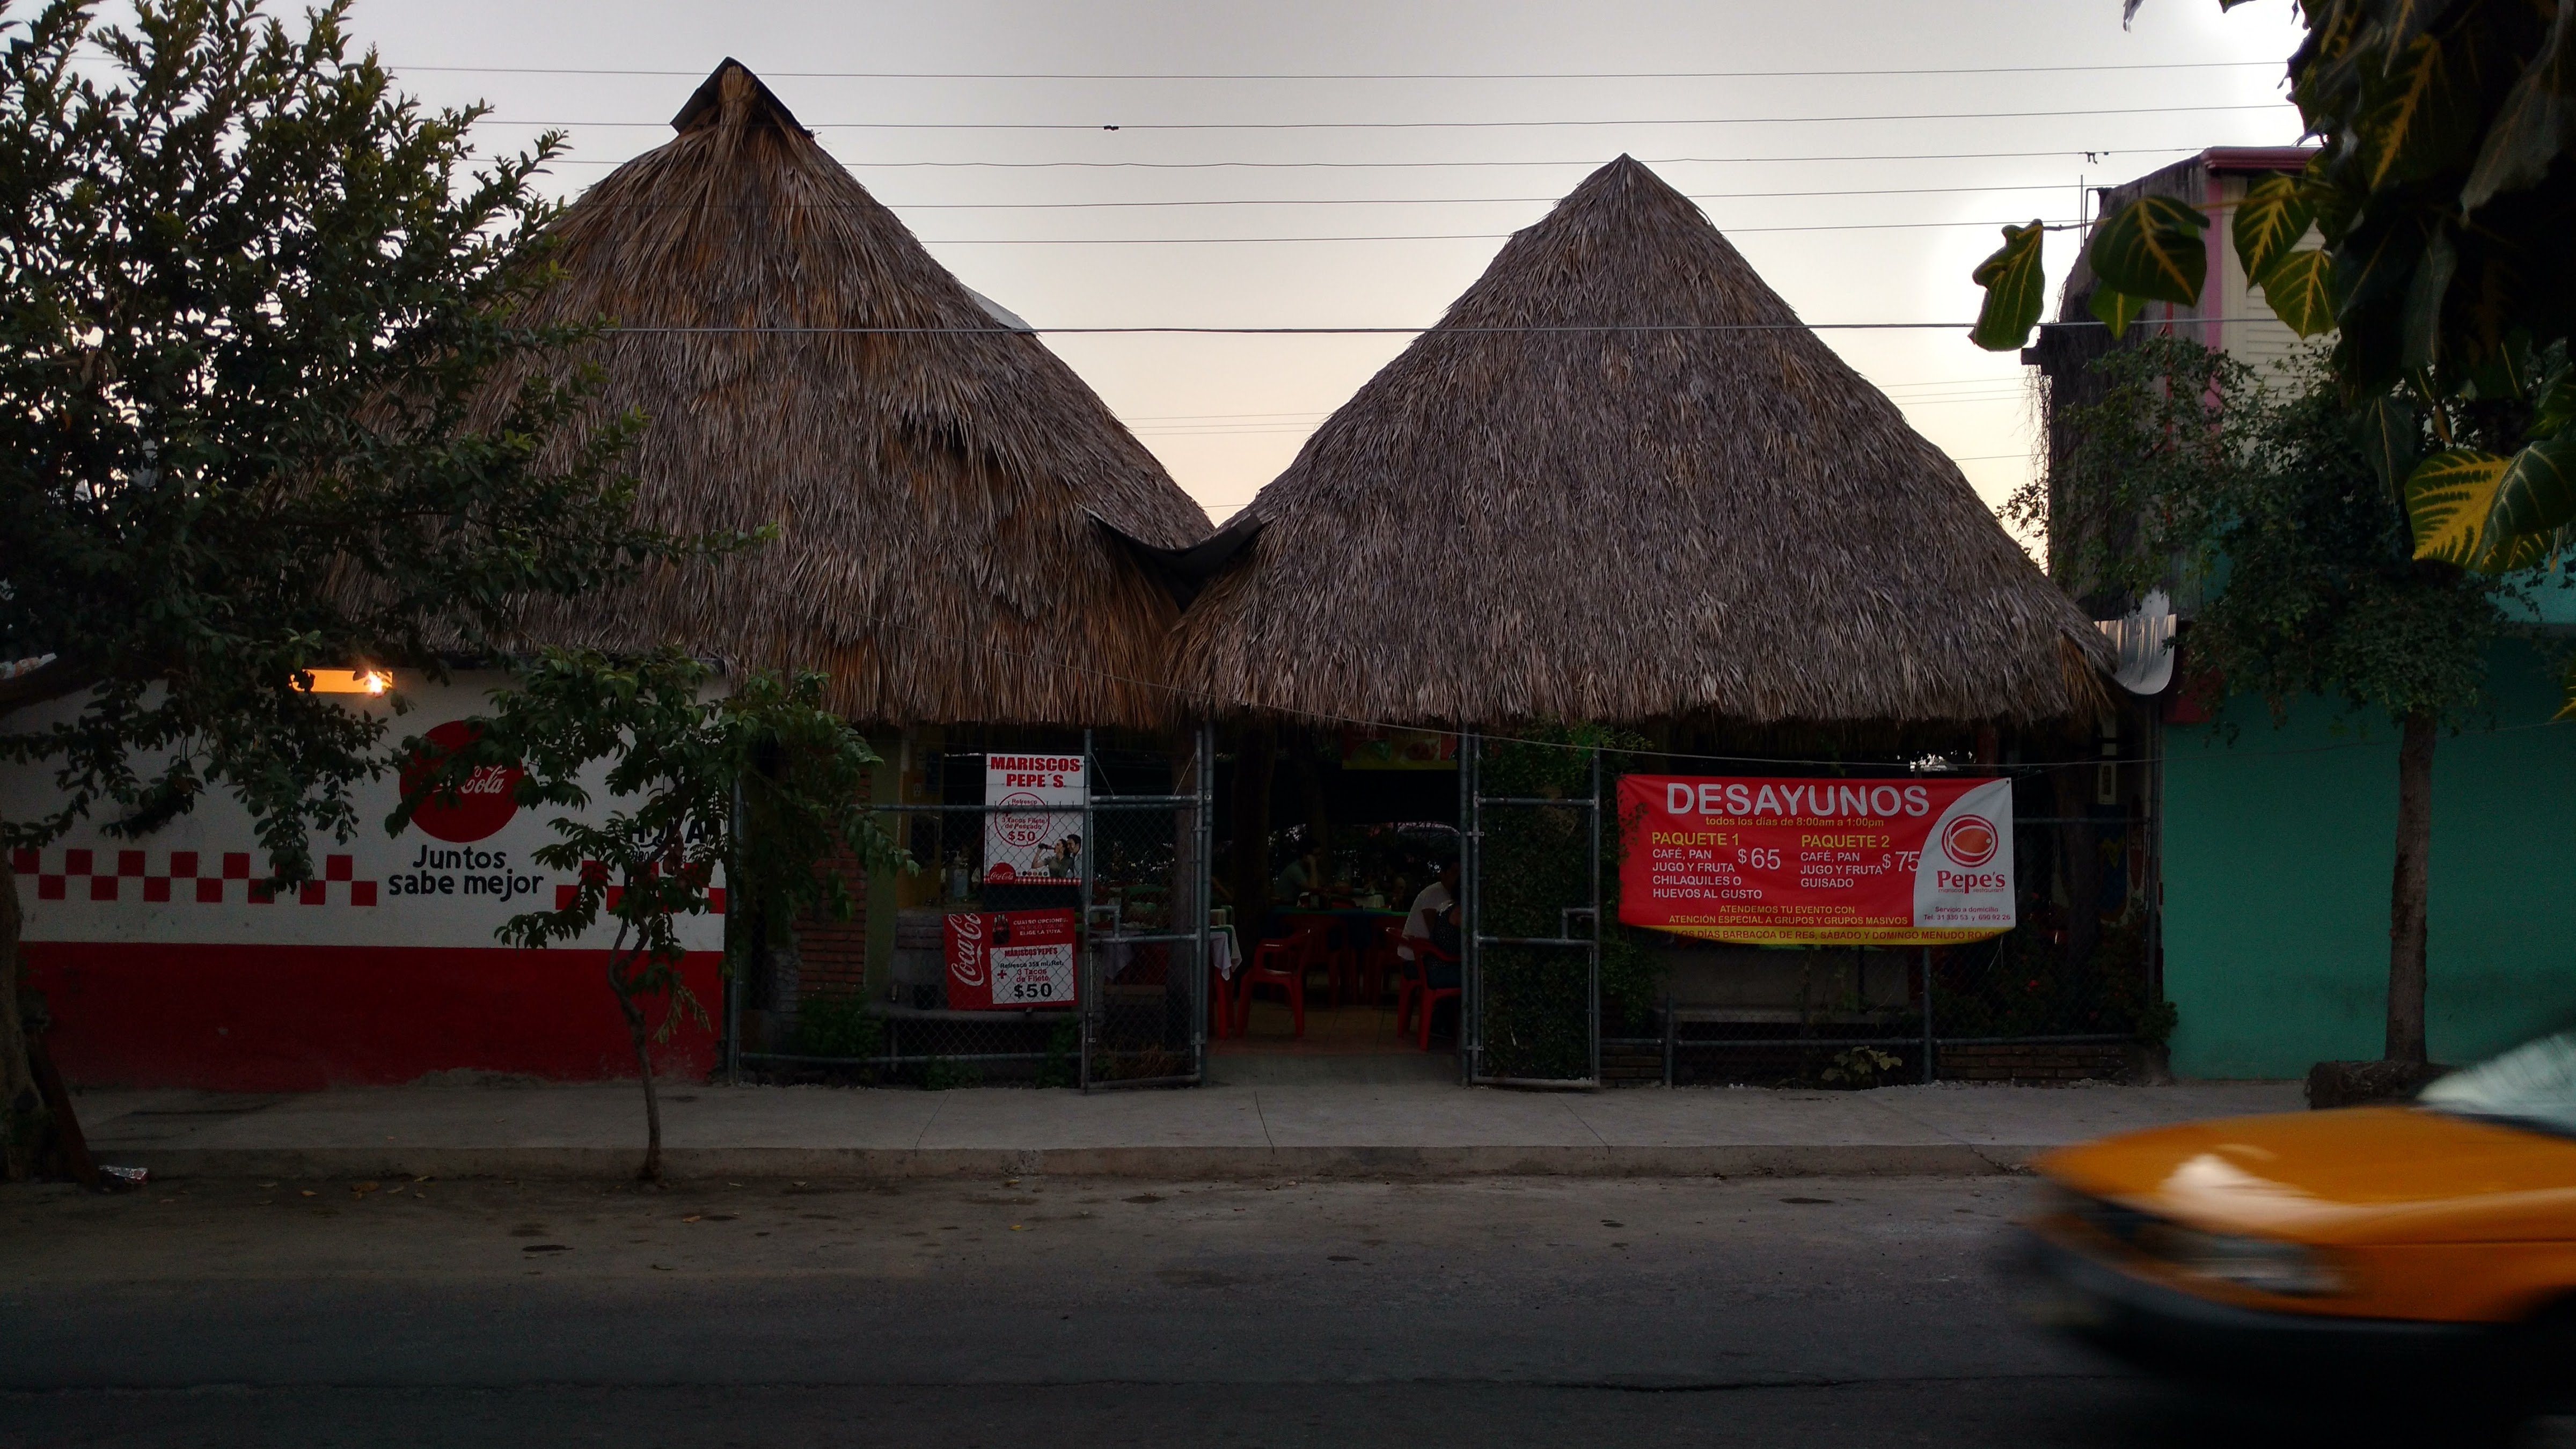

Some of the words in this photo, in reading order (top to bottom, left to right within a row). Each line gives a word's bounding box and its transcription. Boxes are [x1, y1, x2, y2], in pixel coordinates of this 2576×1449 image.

[991, 757, 1080, 772] MARISCOS
[1667, 782, 1930, 817] DESAYUNOS
[1706, 817, 1735, 826] todos
[1738, 817, 1753, 826] los
[1756, 816, 1778, 826] días
[1780, 817, 1794, 826] de
[1796, 817, 1835, 828] 8:00am
[1847, 818, 1885, 829] 1:00pm
[1008, 831, 1036, 841] $50
[1652, 832, 1728, 846] PAQUETE
[1731, 833, 1739, 846] 1
[1801, 835, 1877, 848] PAQUETE
[1881, 835, 1891, 848] 2
[413, 845, 507, 869] Juntos
[1652, 847, 1686, 861] CAFÉ,
[1689, 849, 1712, 859] PAN
[1800, 850, 1834, 863] CAFÉ,
[1837, 852, 1860, 862] PAN
[1652, 862, 1685, 872] JUGO
[1687, 862, 1695, 872] Y
[1697, 863, 1735, 873] FRUTA
[1800, 865, 1833, 875] JUGO
[1835, 865, 1843, 875] Y
[1846, 865, 1883, 875] FRUTA
[389, 870, 455, 895] sabe
[464, 869, 544, 902] mejor
[1652, 875, 1730, 886] CHILAQUILES
[1733, 876, 1742, 886] O
[1800, 878, 1855, 888] GUISADO
[1937, 870, 2006, 894] Pepe's
[1653, 888, 1701, 899] HUEVOS
[1703, 889, 1718, 899] AL
[1721, 889, 1763, 899] GUSTO
[1720, 905, 1779, 913] ATENDEMOS
[1795, 906, 1833, 914] EVENTO
[1669, 913, 1716, 924] ATENCIÓN
[1718, 916, 1763, 924] ESPECIAL
[1774, 917, 1814, 925] GRUPOS
[1824, 917, 1864, 925] GRUPOS
[1866, 917, 1908, 925] MASIVOS
[1697, 929, 1720, 939] DÍAS
[1723, 930, 1777, 939] BARBACOA
[1779, 931, 1793, 939] DE
[1795, 931, 1818, 940] RES,
[1820, 930, 1862, 939] SÁBADO
[1872, 931, 1919, 939] DOMINGO
[1921, 931, 1965, 939] MENUDO
[1005, 948, 1037, 957] MARISCOS
[1014, 983, 1052, 999] $50
